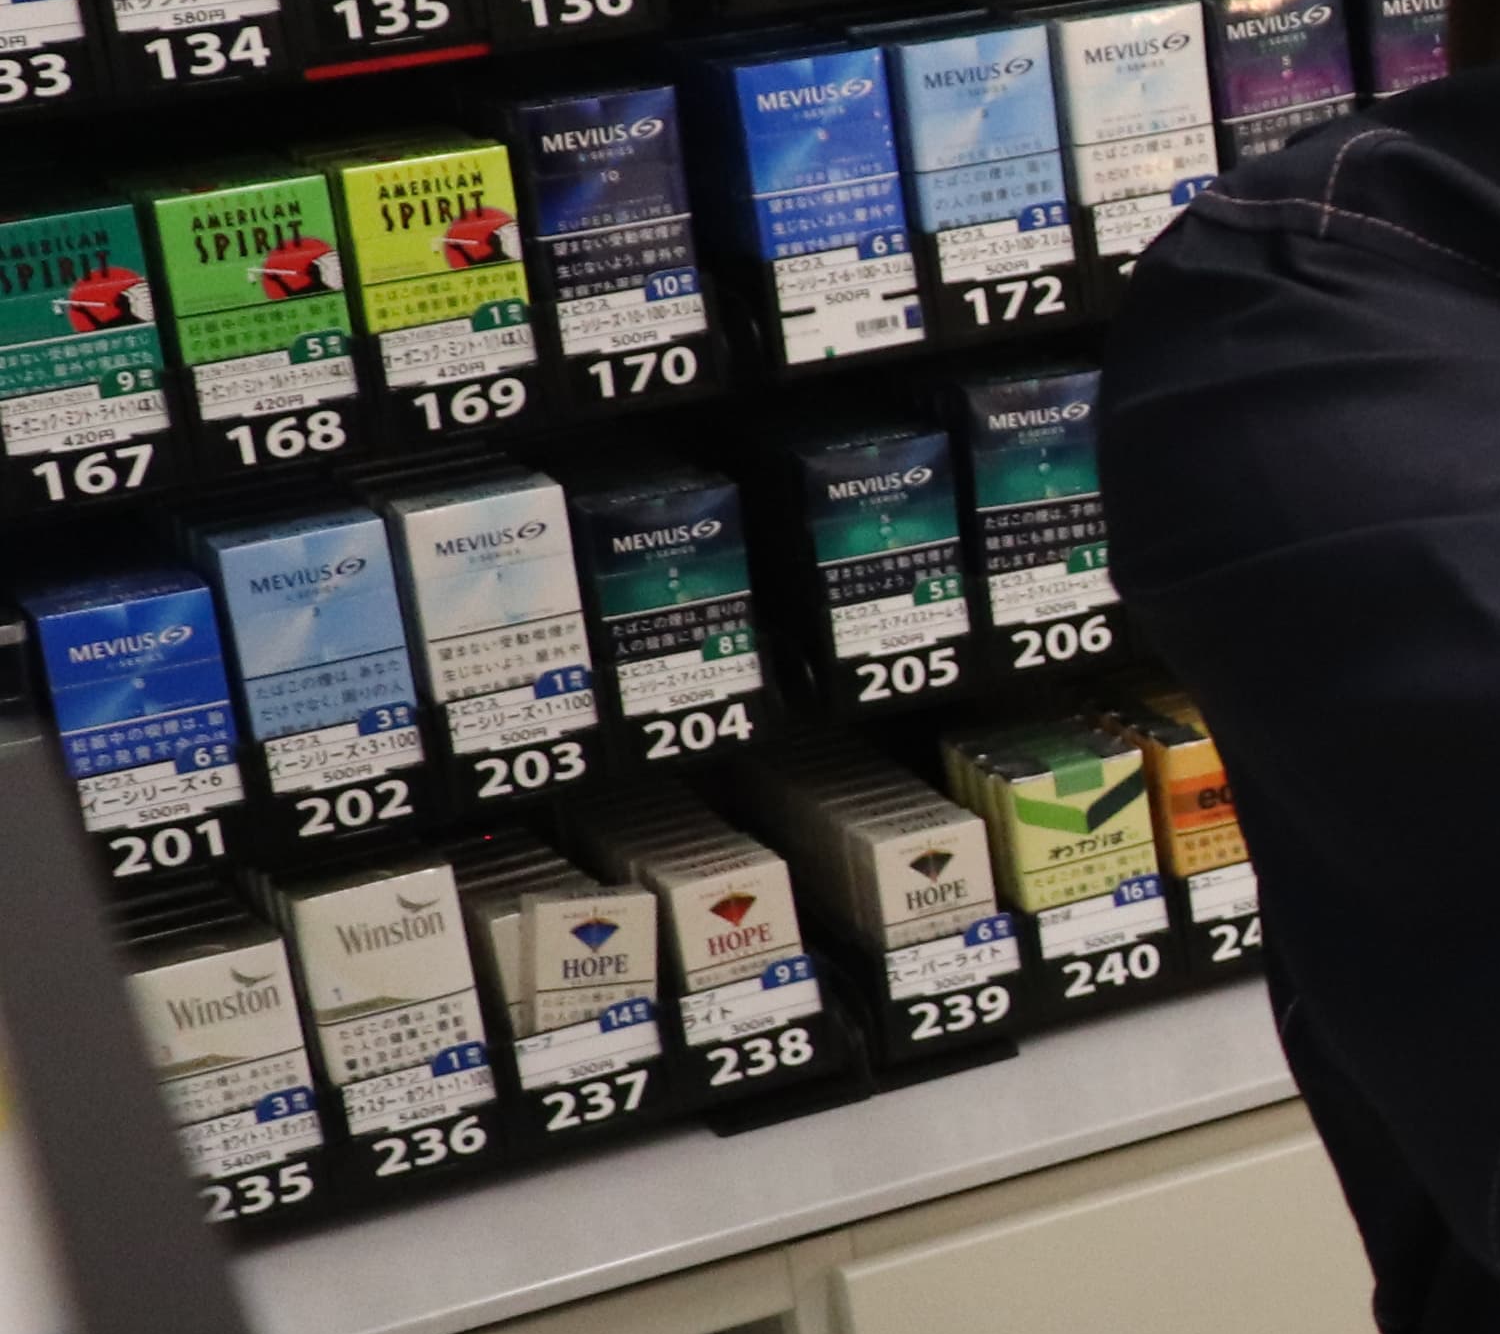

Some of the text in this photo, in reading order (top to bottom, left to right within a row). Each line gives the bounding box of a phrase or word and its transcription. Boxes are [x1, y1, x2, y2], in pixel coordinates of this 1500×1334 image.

[146, 27, 270, 79] 134
[924, 63, 1003, 89] MEVIUS
[1084, 39, 1162, 65] MEVIUS
[757, 84, 839, 113] MEVIUS
[542, 123, 627, 153] MEVIUS
[378, 171, 484, 202] AMERICAN
[381, 190, 485, 233] SPIRIT
[191, 201, 301, 232] AMERICAN
[194, 221, 303, 265] SPIRIT
[964, 276, 1065, 324] 172
[589, 347, 696, 397] 170
[414, 378, 525, 429] 169
[226, 411, 345, 464] 168
[33, 444, 152, 500] 167
[827, 472, 902, 500] MEVIUS
[436, 531, 515, 559] MEVIUS
[251, 564, 333, 595] MEVIUS
[69, 634, 157, 664] MEVIUS
[1012, 615, 1111, 667] 206
[857, 648, 958, 701] 205
[644, 704, 752, 759] 204
[475, 743, 585, 797] 203
[296, 780, 412, 836] 202
[110, 819, 224, 876] 201
[1049, 829, 1125, 860] わかば
[906, 879, 968, 910] HOPE
[336, 904, 445, 956] Winston
[707, 922, 771, 956] HOPE
[561, 954, 628, 981] HOPE
[1063, 945, 1159, 997] 240
[167, 981, 281, 1031] Winston
[909, 986, 1009, 1040] 239
[707, 1028, 812, 1085] 238
[543, 1070, 647, 1130] 237
[373, 1116, 486, 1176] 236
[203, 1162, 312, 1221] 235
